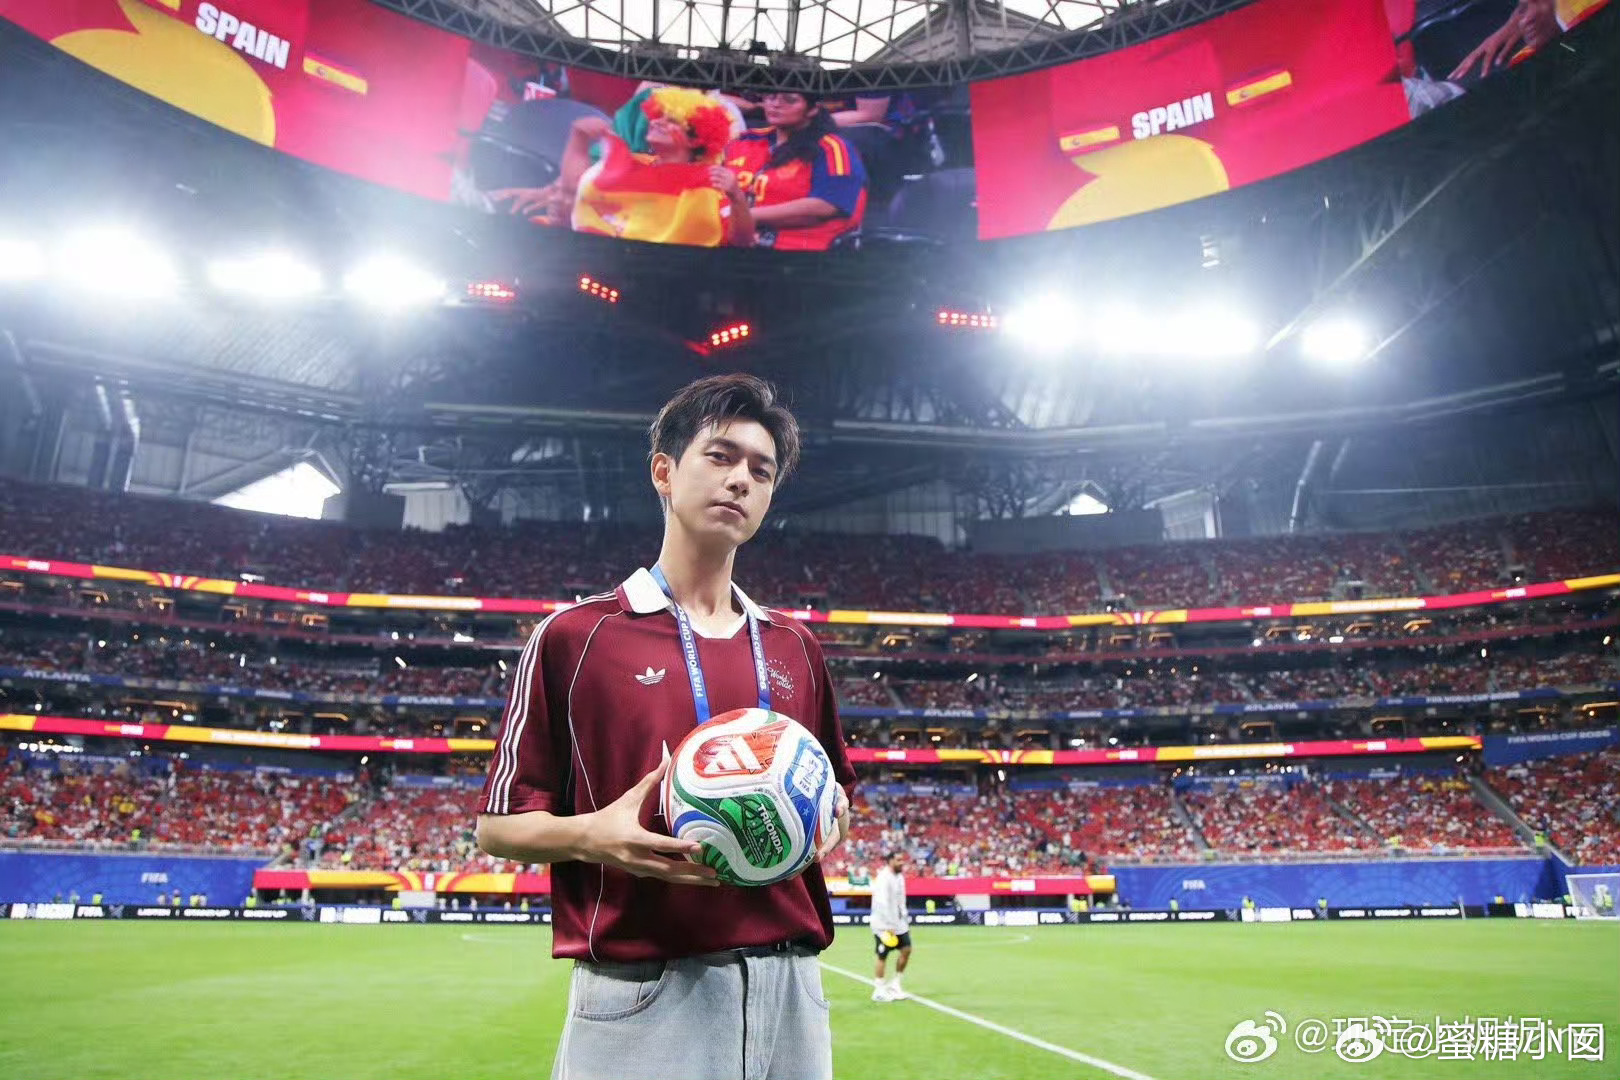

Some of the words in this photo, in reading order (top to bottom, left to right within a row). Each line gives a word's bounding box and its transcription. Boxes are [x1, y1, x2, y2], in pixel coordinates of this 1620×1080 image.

[195, 1, 290, 70] SPAIN
[1131, 92, 1215, 140] SPAIN
[681, 623, 691, 640] CUP
[685, 642, 698, 674] WORLD
[23, 669, 91, 682] ATLANTA
[693, 674, 704, 697] FIFA
[757, 803, 784, 855] TRIONDA
[141, 872, 168, 883] FIFA
[1183, 879, 1206, 890] FIFA
